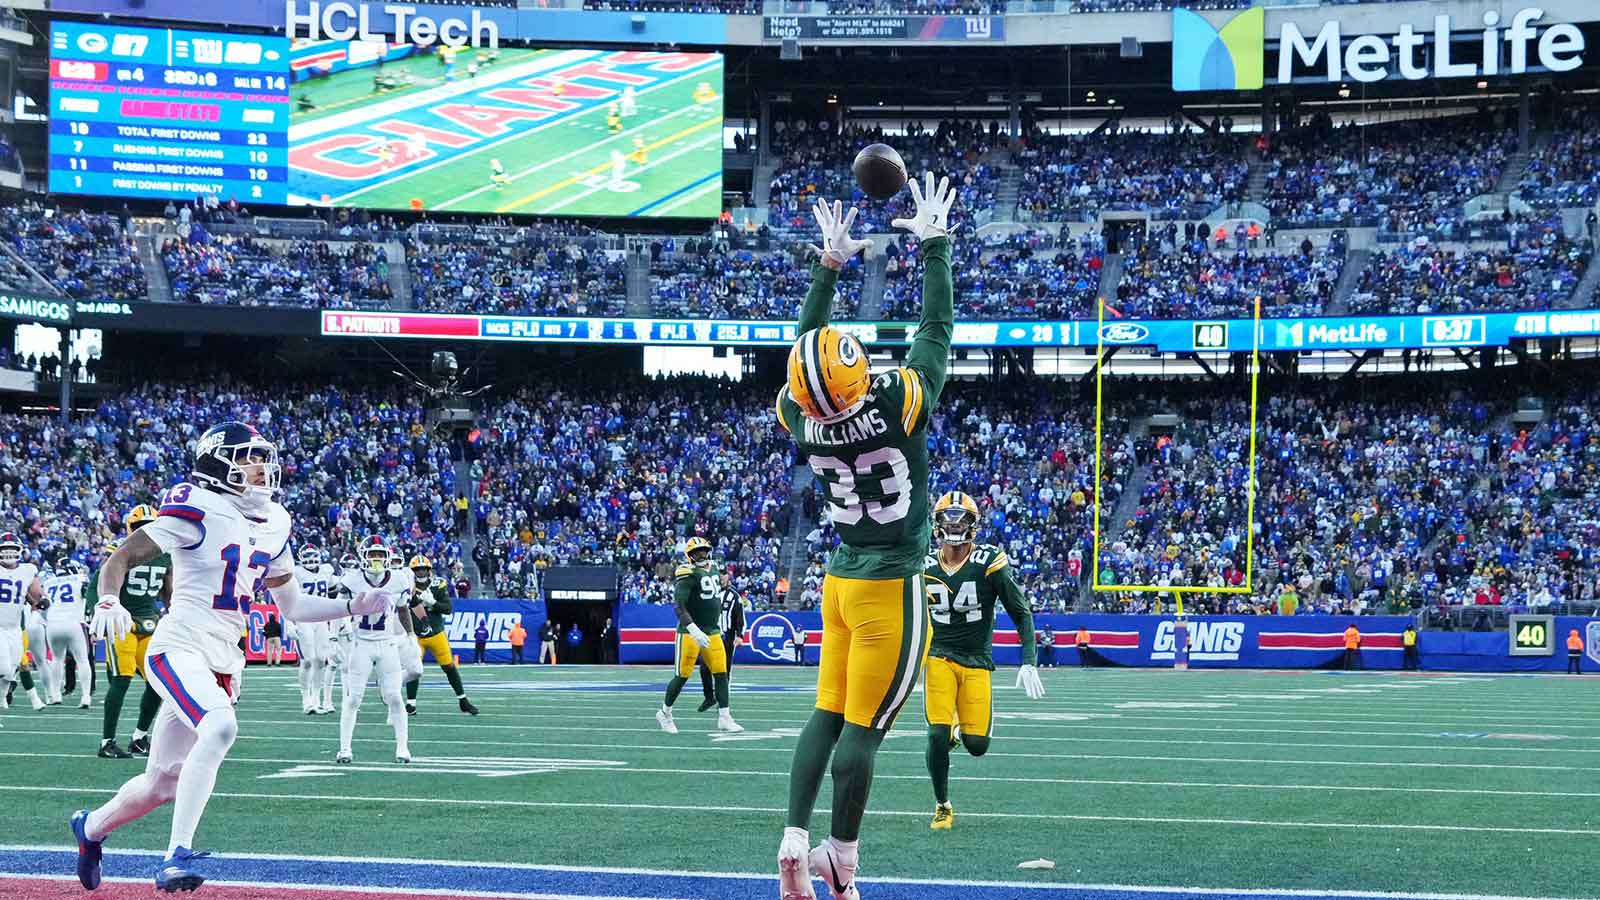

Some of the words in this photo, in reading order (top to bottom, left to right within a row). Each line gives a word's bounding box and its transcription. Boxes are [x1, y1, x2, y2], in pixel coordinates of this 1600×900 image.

[286, 0, 499, 48] HCLTech
[770, 17, 798, 26] Need
[770, 26, 802, 38] Help?
[1278, 8, 1585, 84] MetLife
[265, 76, 286, 90] 14
[288, 51, 713, 179] GIANTS
[117, 126, 150, 137] TOTAL
[150, 128, 180, 138] FIRST
[180, 130, 221, 141] DOWNS
[247, 133, 268, 145] 22
[73, 140, 84, 153] 7
[185, 148, 224, 160] DOWNS
[69, 158, 88, 170] 11
[249, 151, 268, 163] 10
[112, 161, 156, 173] PASSING
[184, 166, 224, 177] DOWNS
[249, 168, 268, 180] 10
[112, 178, 137, 189] FIRST
[185, 183, 223, 194] PENALTY
[567, 322, 577, 338] 7
[1198, 326, 1223, 347] 40
[1308, 323, 1388, 344] MetLife
[804, 408, 888, 445] WILLIAMS
[164, 484, 193, 504] 13
[808, 446, 913, 526] 33
[127, 565, 168, 597] 55
[0, 578, 23, 604] 61
[47, 584, 75, 603] 72
[926, 581, 983, 624] 24
[1153, 621, 1245, 652] GANTS
[1517, 625, 1545, 646] 40
